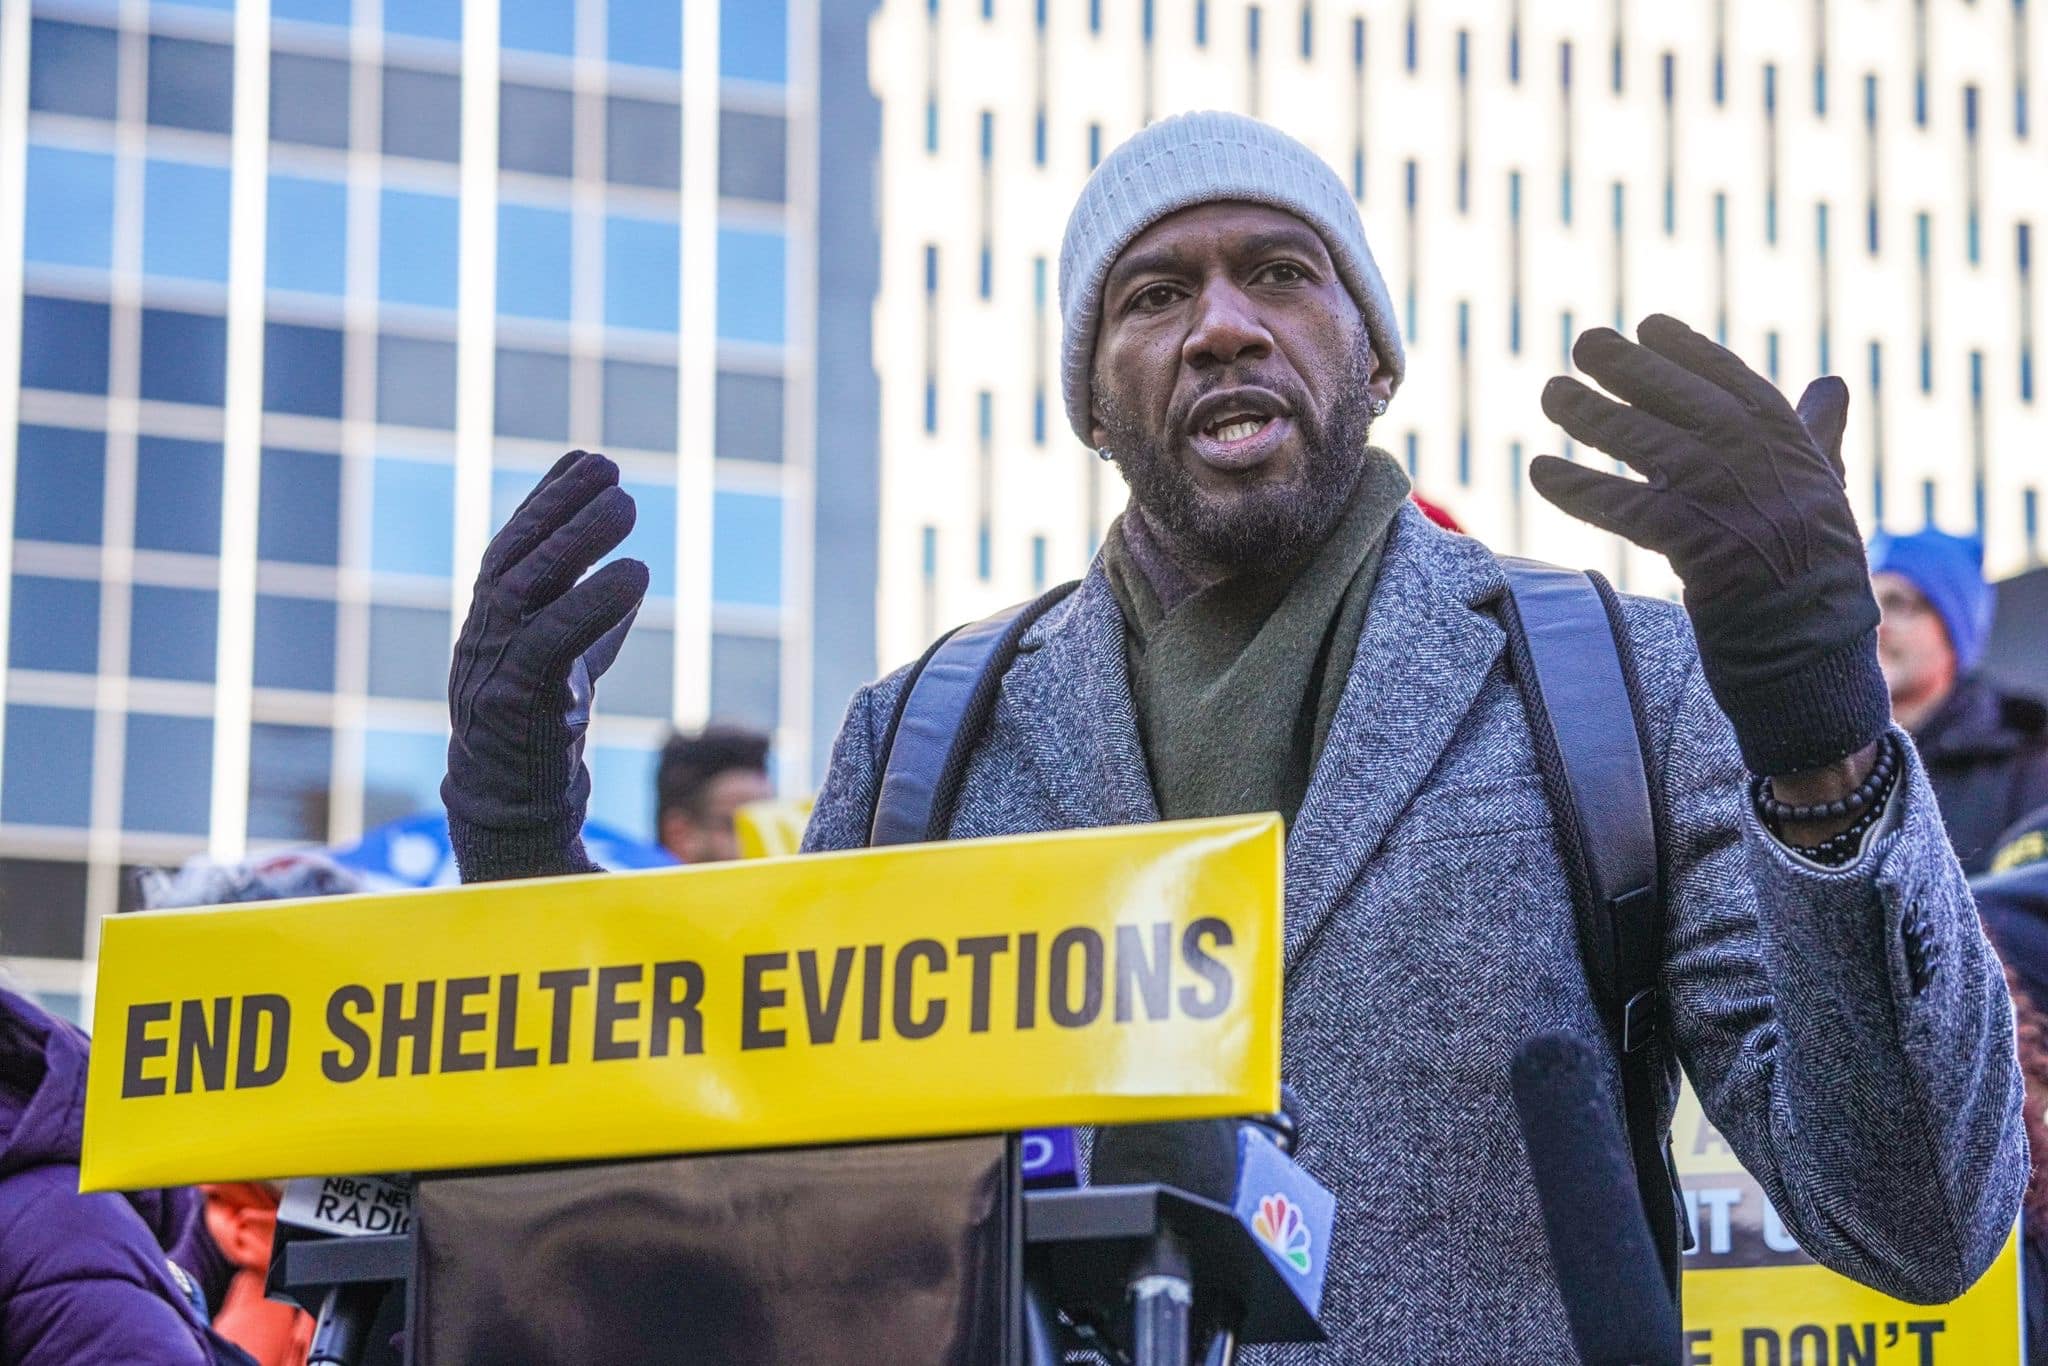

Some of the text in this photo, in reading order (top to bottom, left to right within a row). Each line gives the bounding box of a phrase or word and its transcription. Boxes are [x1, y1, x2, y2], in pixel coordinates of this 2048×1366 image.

[121, 916, 1234, 1099] END SHELTER EVICTIONS
[323, 1177, 411, 1209] NBC NE
[1742, 1319, 1946, 1366] DON'T
